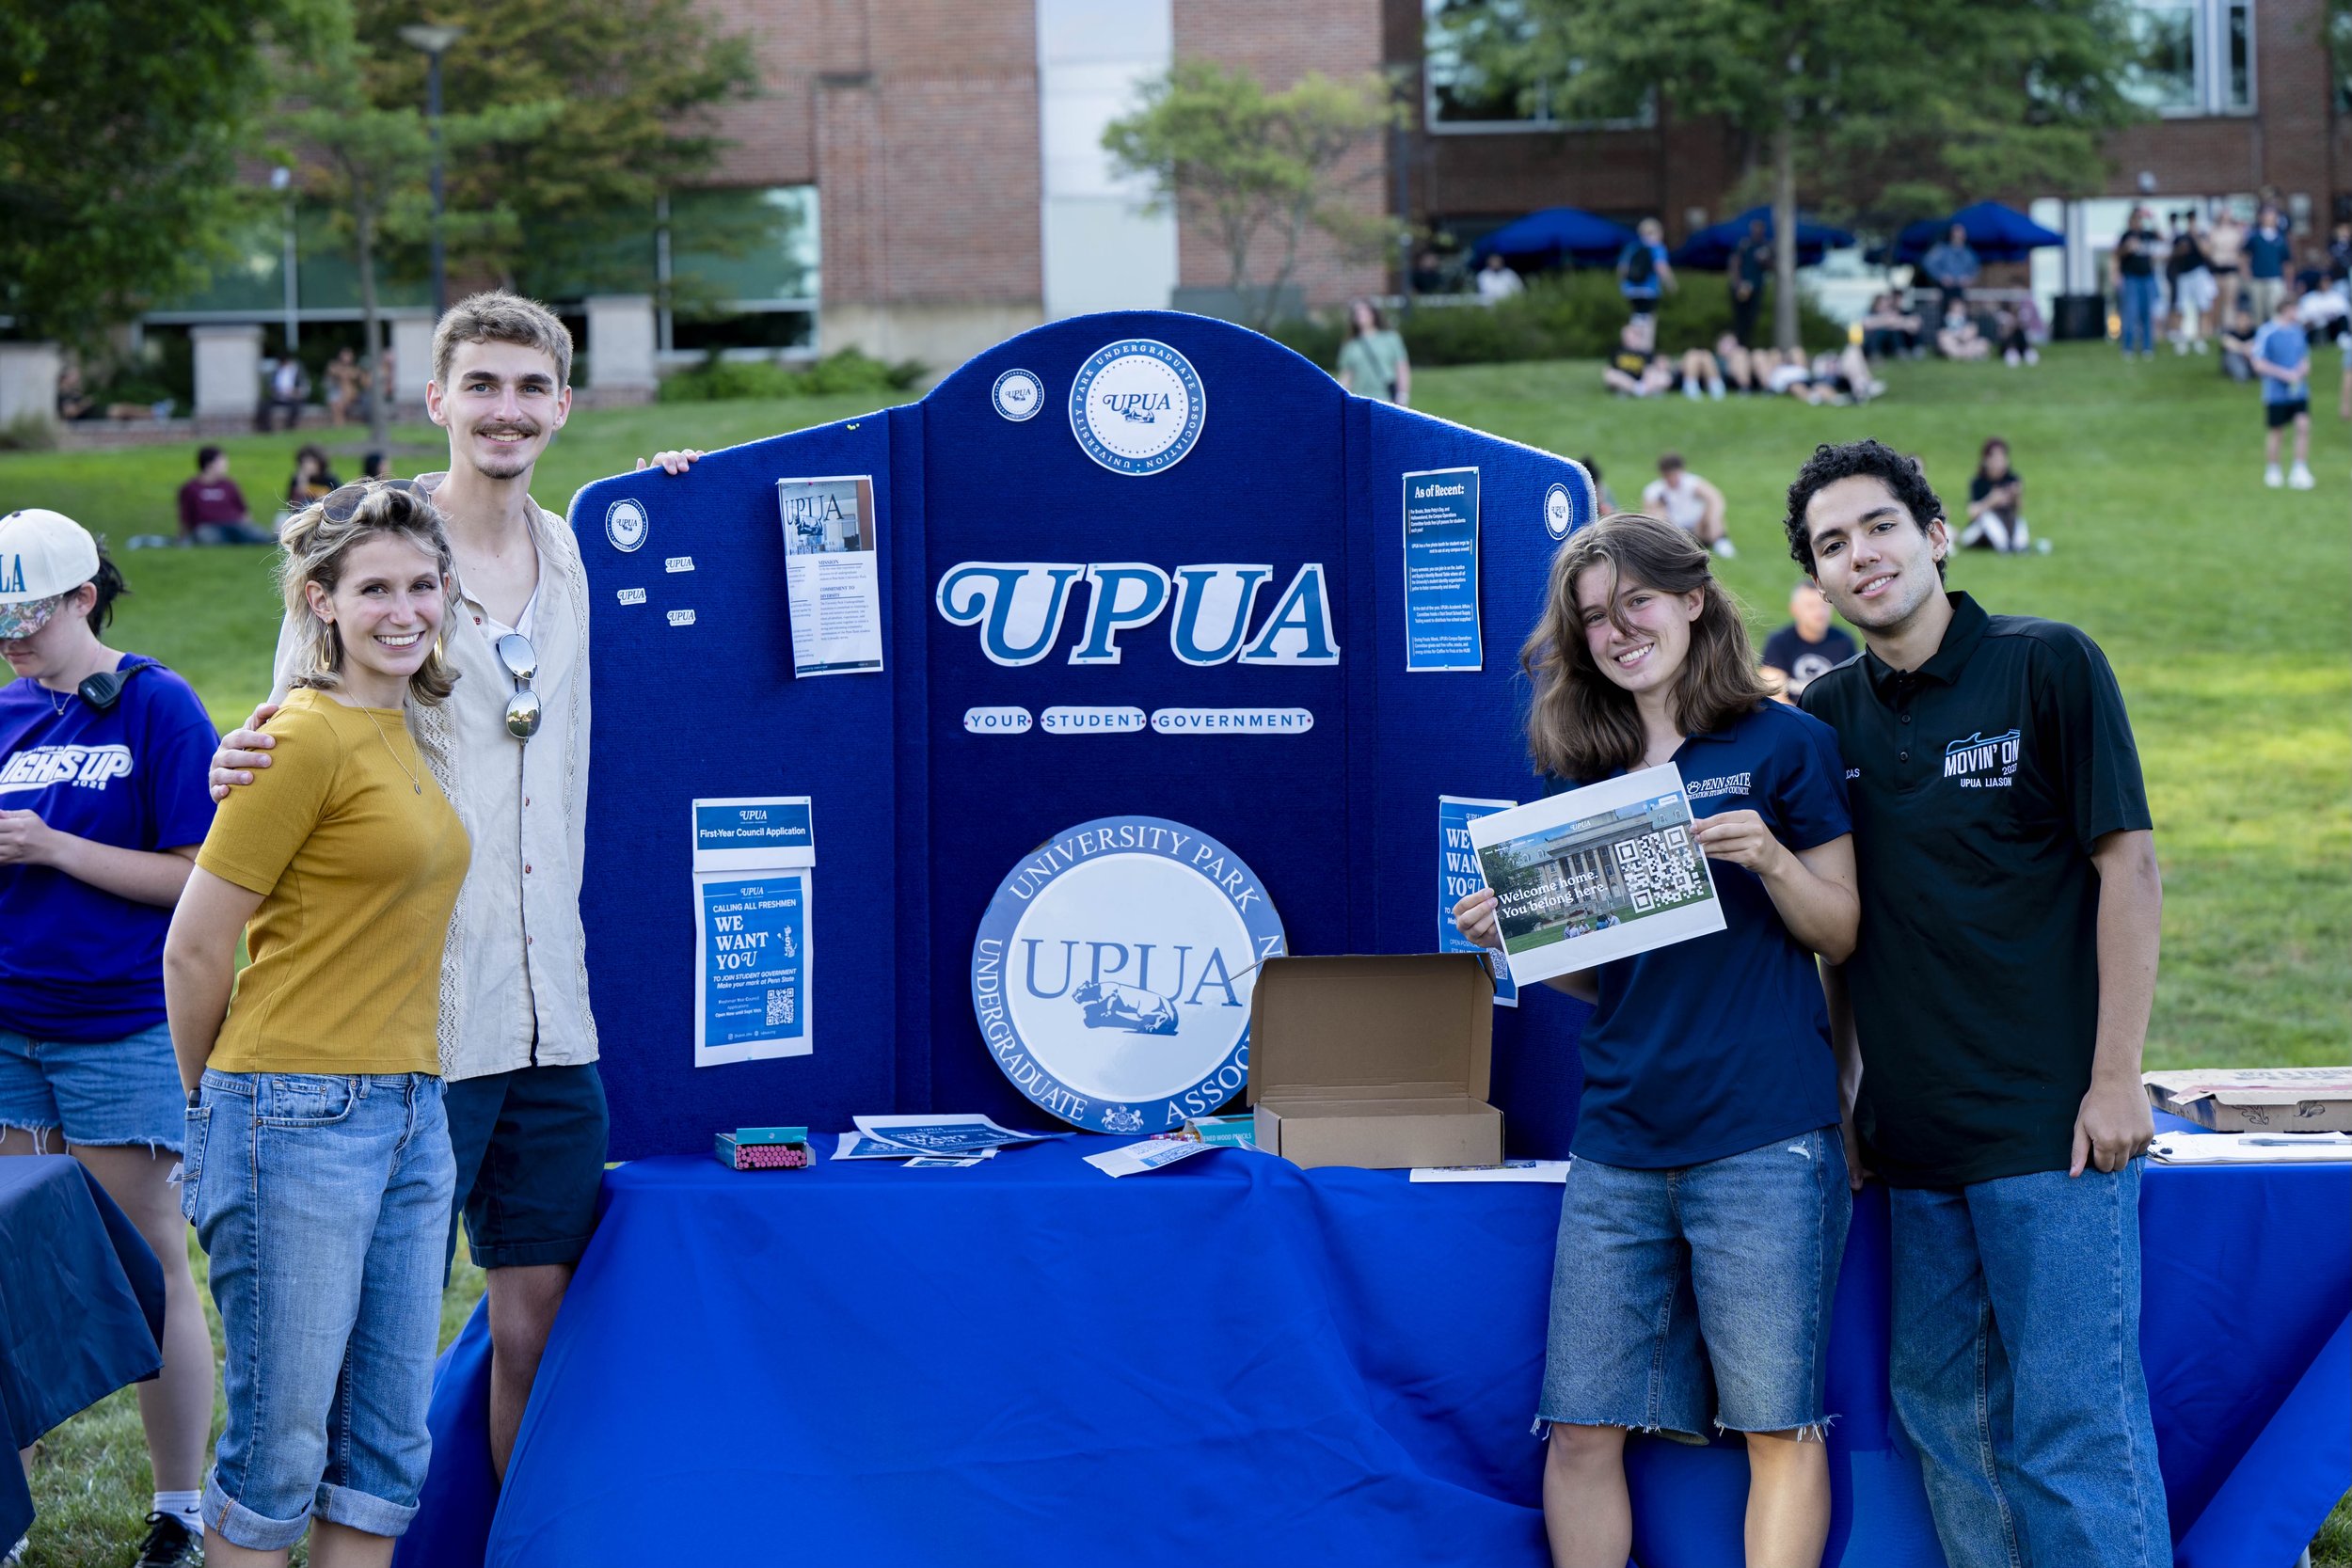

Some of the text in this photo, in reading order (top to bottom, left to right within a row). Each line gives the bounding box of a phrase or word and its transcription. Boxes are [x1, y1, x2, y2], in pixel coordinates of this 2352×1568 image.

[1075, 344, 1199, 468] UNIVERSITY PARK UNDERGRADUATE ASSOCIATION
[1103, 393, 1171, 412] UPUA
[1415, 483, 1465, 499] As of Recent:
[786, 493, 845, 525] UPUA
[667, 558, 691, 567] UPUA
[618, 590, 644, 600] UPUA
[668, 611, 694, 621] UPUA
[939, 564, 1338, 665] UPUA
[971, 714, 1307, 728] YOUR STUDENT GOVERNMENT
[1944, 738, 2020, 778] MOVIN' ON
[1701, 772, 1751, 791] PENN STATE
[1960, 777, 2012, 787] UPUA LIASON
[1688, 785, 1750, 800] DUCATION STUDENT COUNCIL
[739, 810, 768, 820] UPUA
[700, 827, 806, 838] First-Year Council Application
[1569, 819, 1591, 831] UPUA
[1446, 828, 1470, 849] WE
[1008, 825, 1262, 915] UNIVERSITY PARK
[1446, 852, 1481, 875] WAN
[740, 887, 764, 896] UPUA
[1446, 876, 1482, 897] YOU
[1498, 870, 1599, 906] Welcome home.
[712, 903, 743, 912] CALLING
[758, 899, 797, 910] FRESHMEN
[1502, 884, 1608, 919] You belong here.
[714, 915, 744, 932] WE
[715, 931, 769, 951] WANT
[715, 951, 757, 971] YOU
[735, 972, 760, 981] STUDENT
[760, 968, 797, 978] GOVERNMENT
[1021, 938, 1244, 1007] UPUA
[976, 938, 1089, 1122] UNDERGRADUATE
